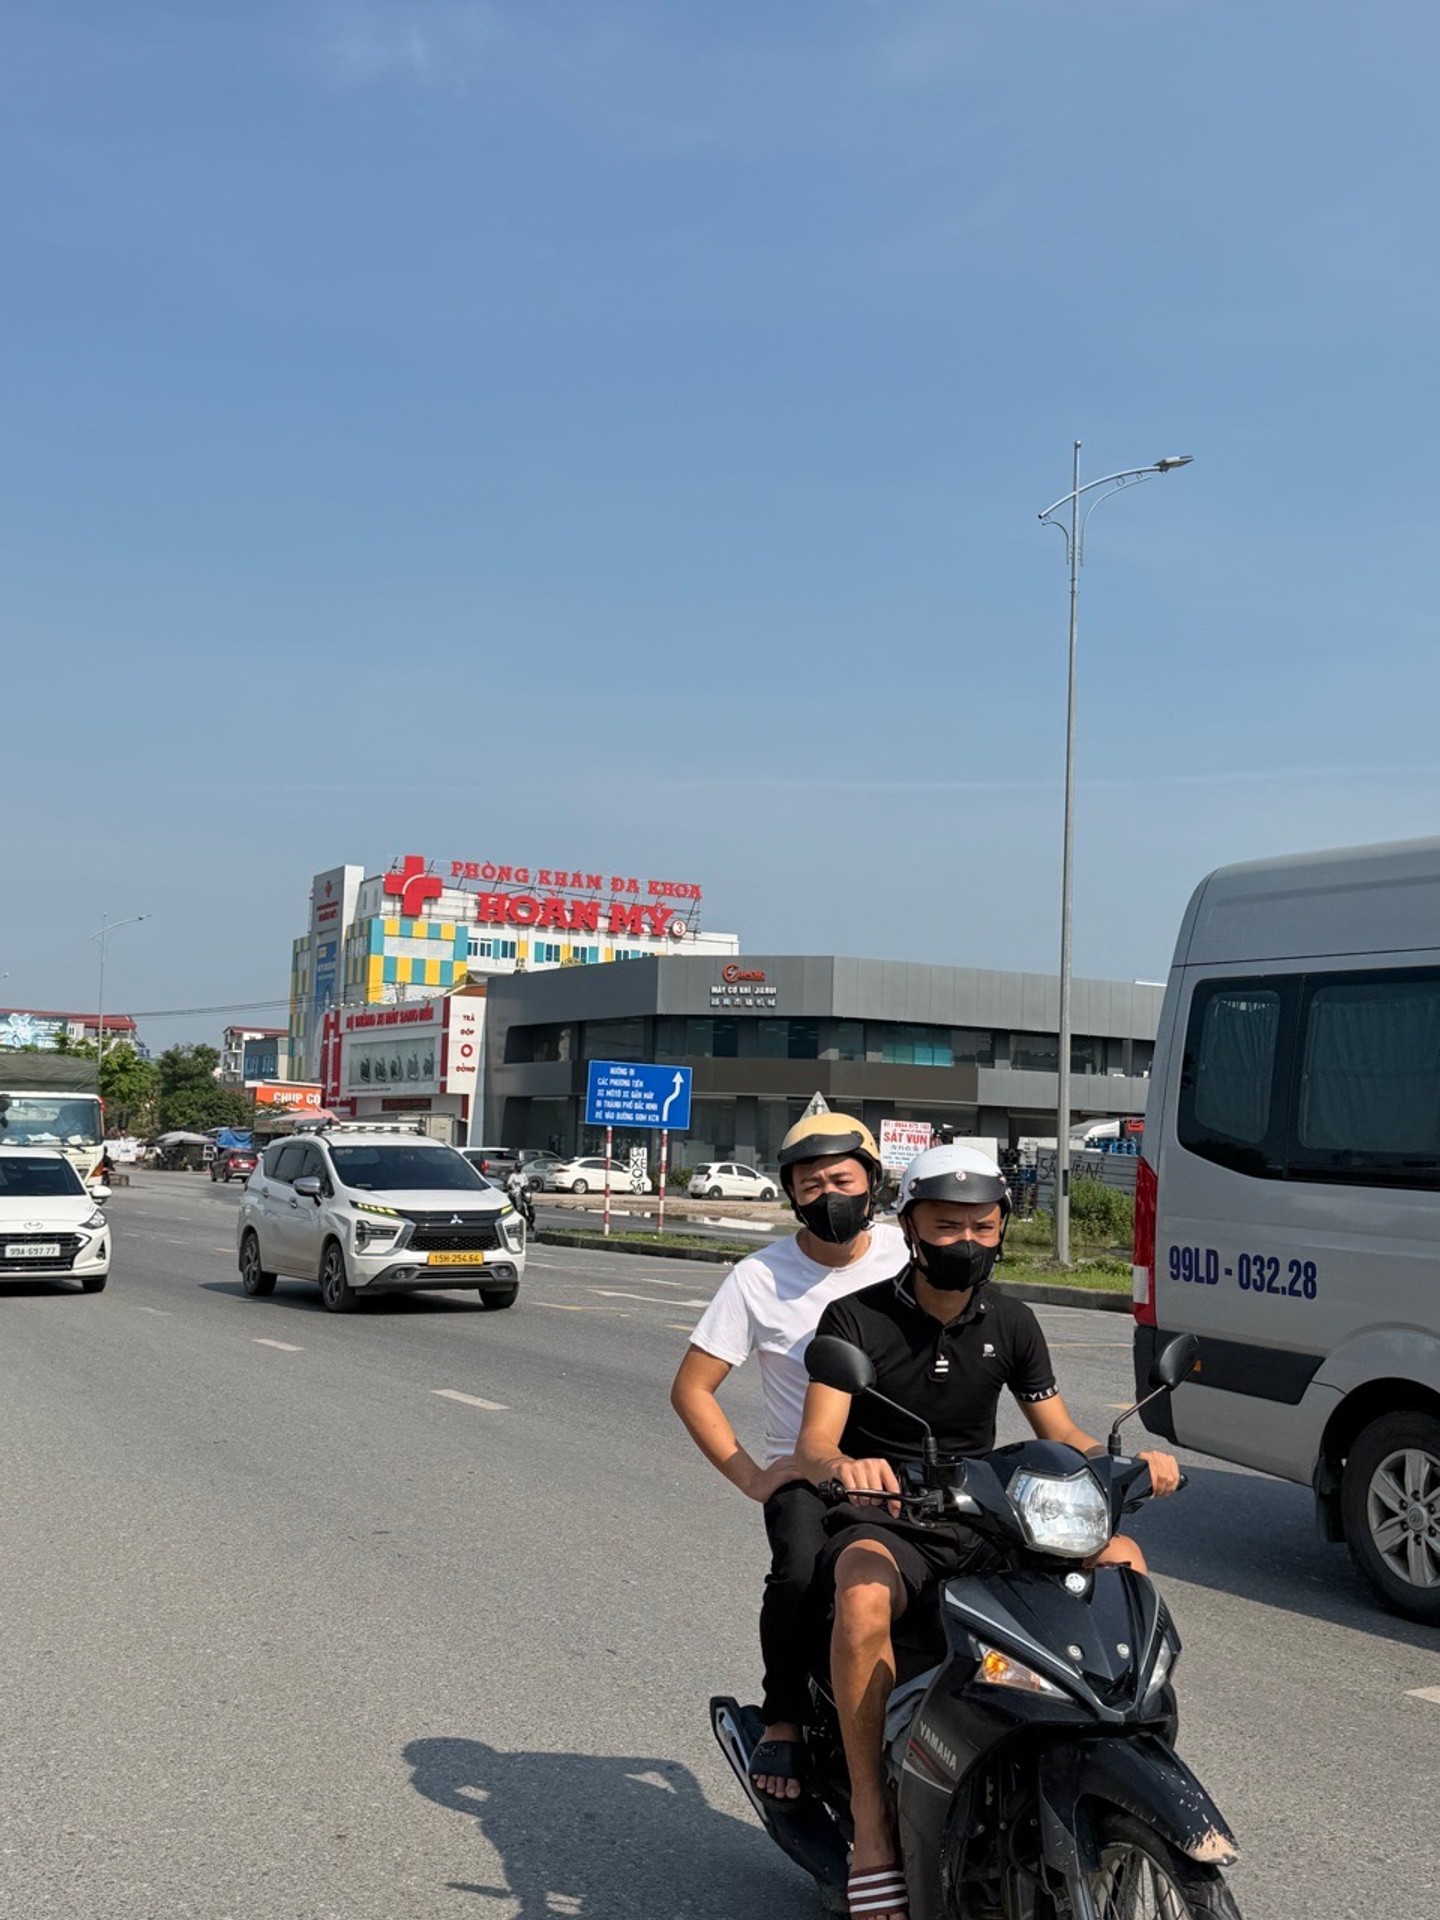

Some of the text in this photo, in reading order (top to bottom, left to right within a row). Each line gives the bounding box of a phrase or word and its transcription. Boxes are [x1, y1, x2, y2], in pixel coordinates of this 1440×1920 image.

[451, 860, 529, 883] PHÒNG
[648, 880, 702, 899] KHOA
[477, 889, 601, 932] HOÀN
[608, 902, 674, 936] MỸ
[1169, 1245, 1219, 1285] 99LD
[1238, 1253, 1317, 1300] 032.28
[920, 1720, 957, 1771] YAMAHA
